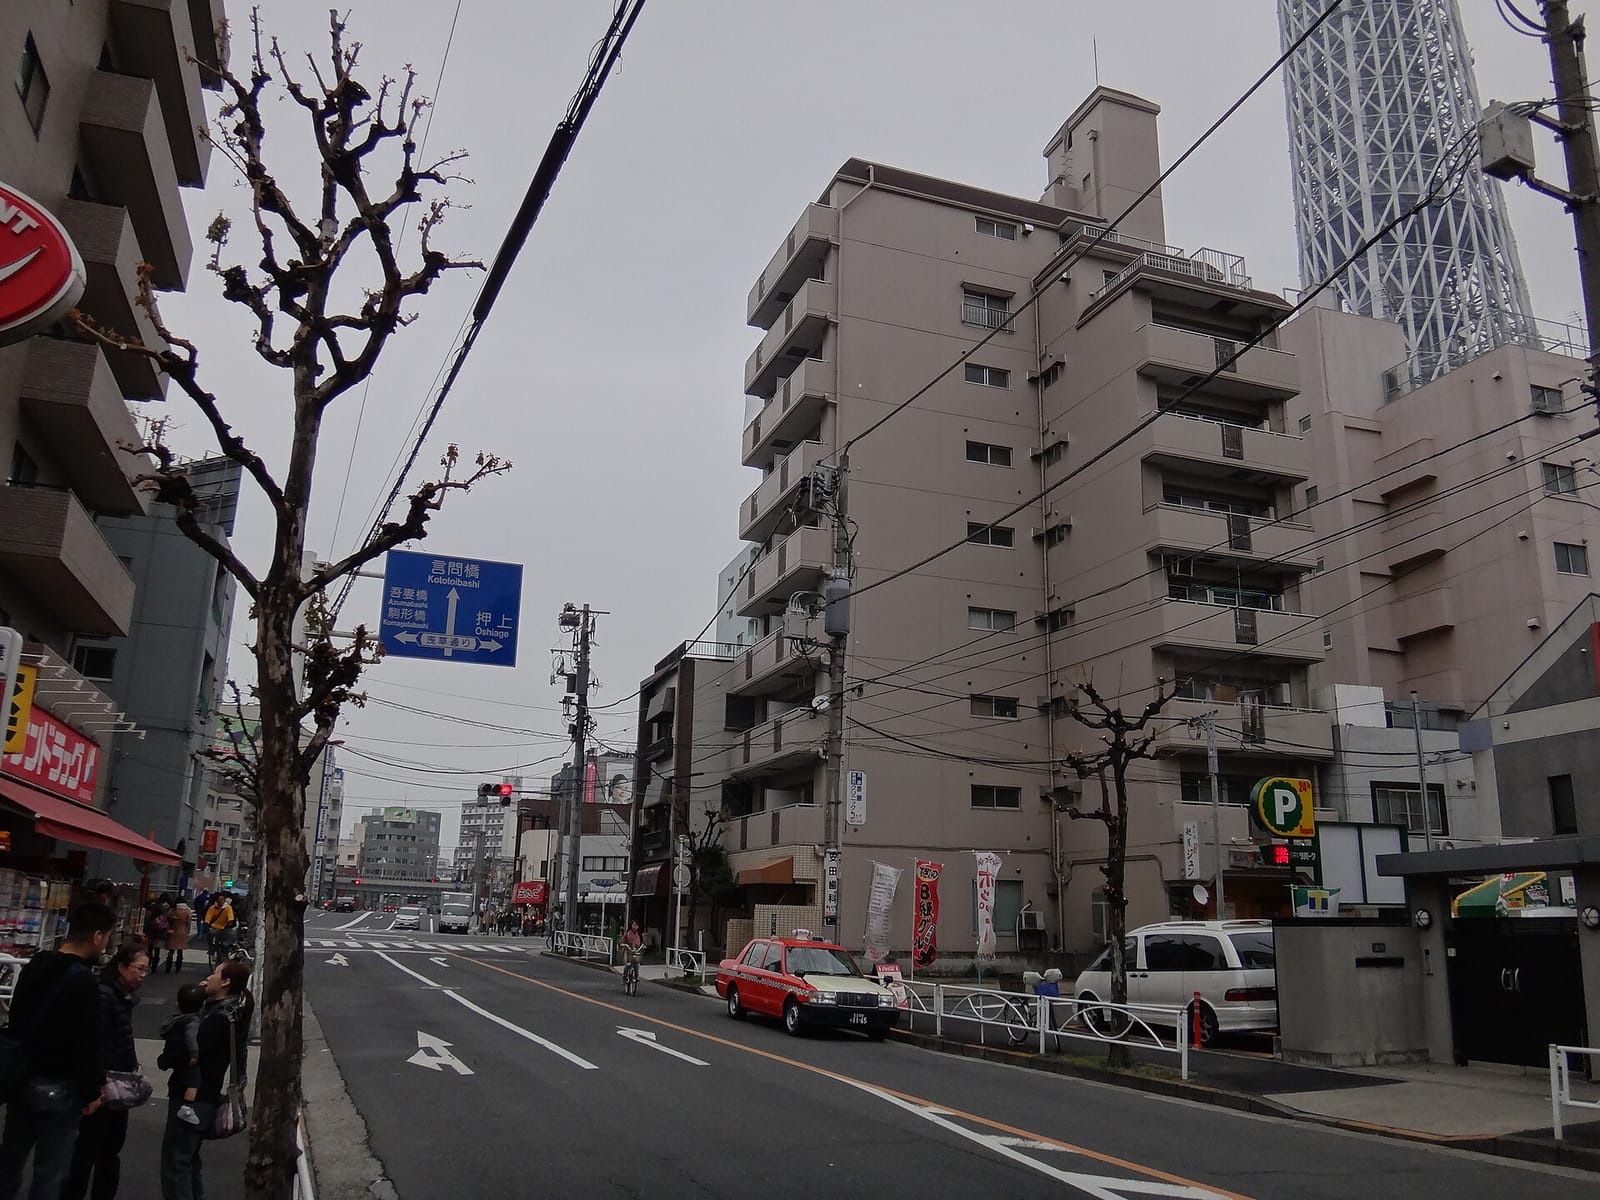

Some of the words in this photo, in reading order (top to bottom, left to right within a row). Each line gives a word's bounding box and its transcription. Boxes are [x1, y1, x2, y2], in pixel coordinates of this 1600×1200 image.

[431, 560, 480, 579] 言問橋
[389, 586, 428, 601] 吾妻橋
[476, 611, 513, 629] 押上
[474, 627, 509, 638] Oshiage
[8, 721, 84, 790] ンドラッグ
[1274, 788, 1297, 825] P
